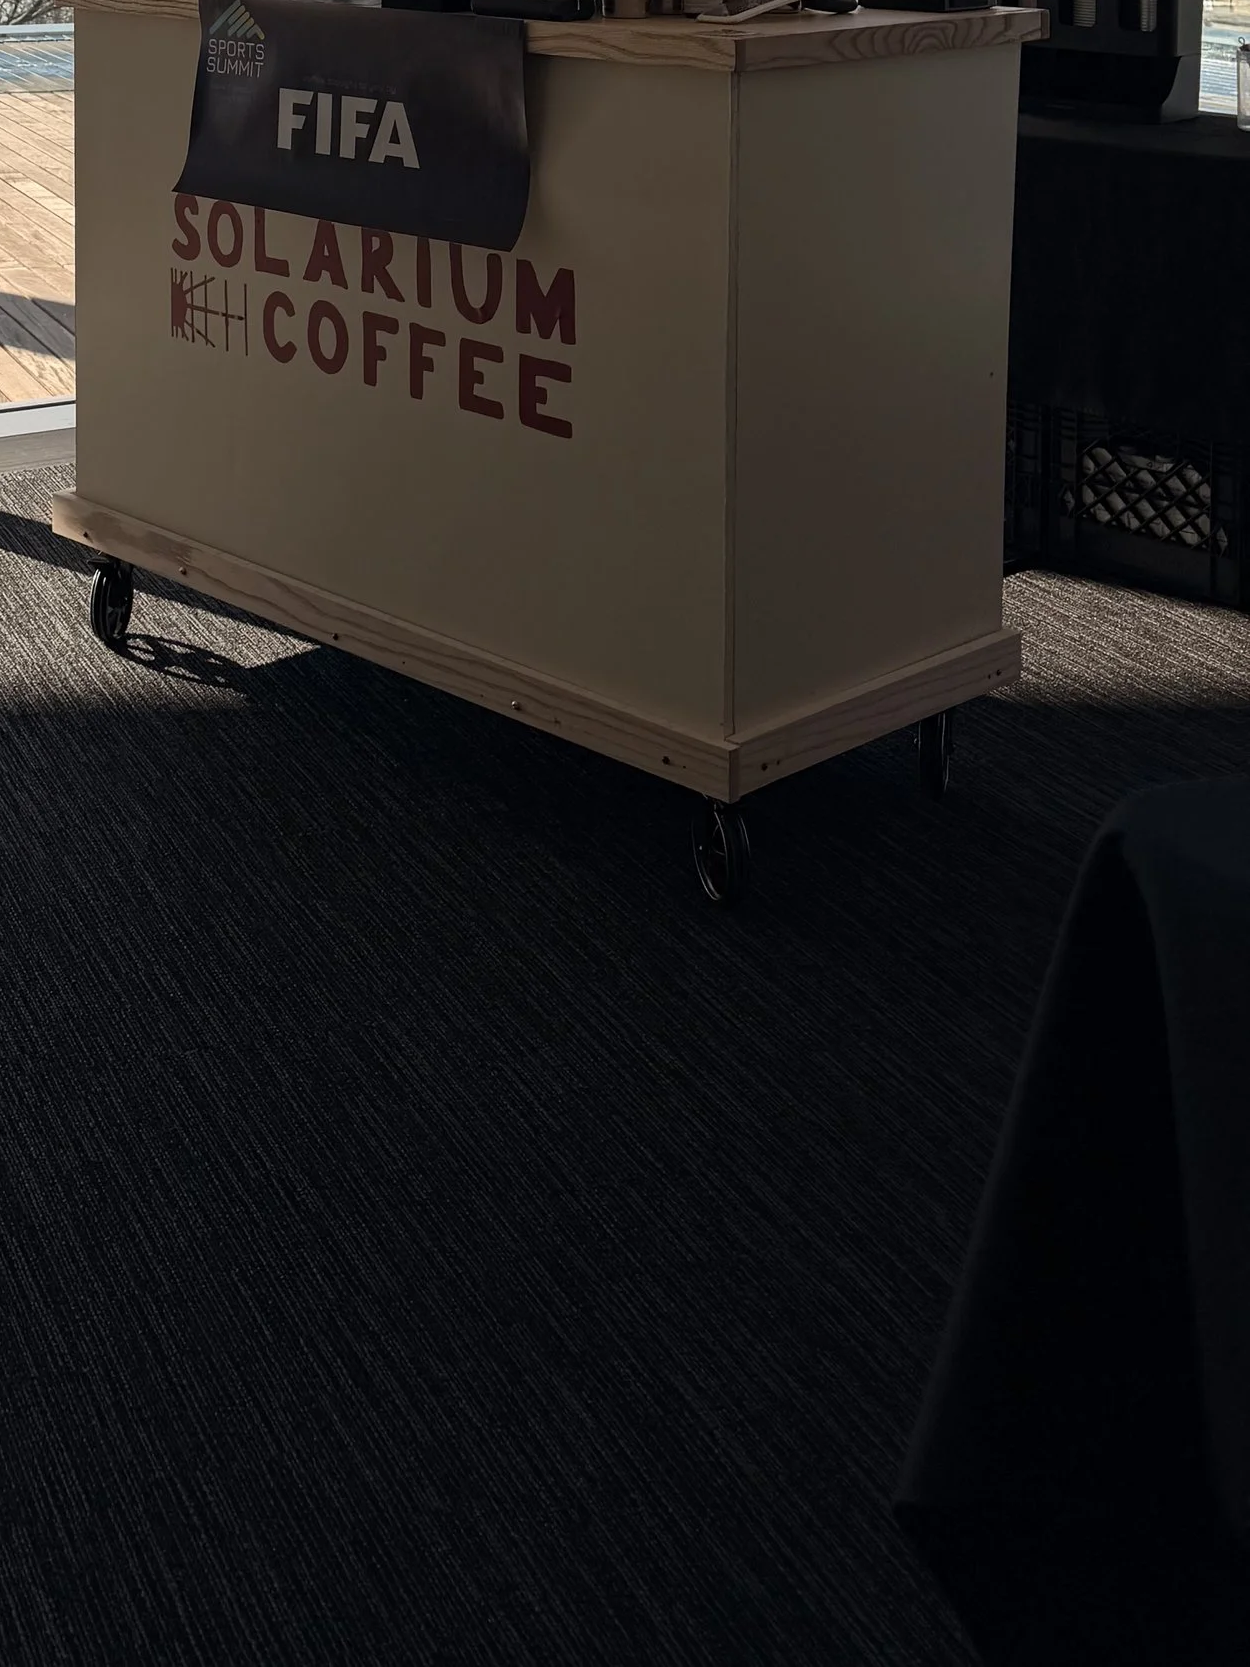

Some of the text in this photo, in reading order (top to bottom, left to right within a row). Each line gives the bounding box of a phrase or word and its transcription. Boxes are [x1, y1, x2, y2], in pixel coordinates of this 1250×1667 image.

[206, 56, 265, 78] SUMMIT
[208, 38, 265, 60] SPORTS
[276, 87, 421, 169] FIFA
[171, 192, 577, 346] SOLARIUM
[262, 290, 573, 439] COFFEE
